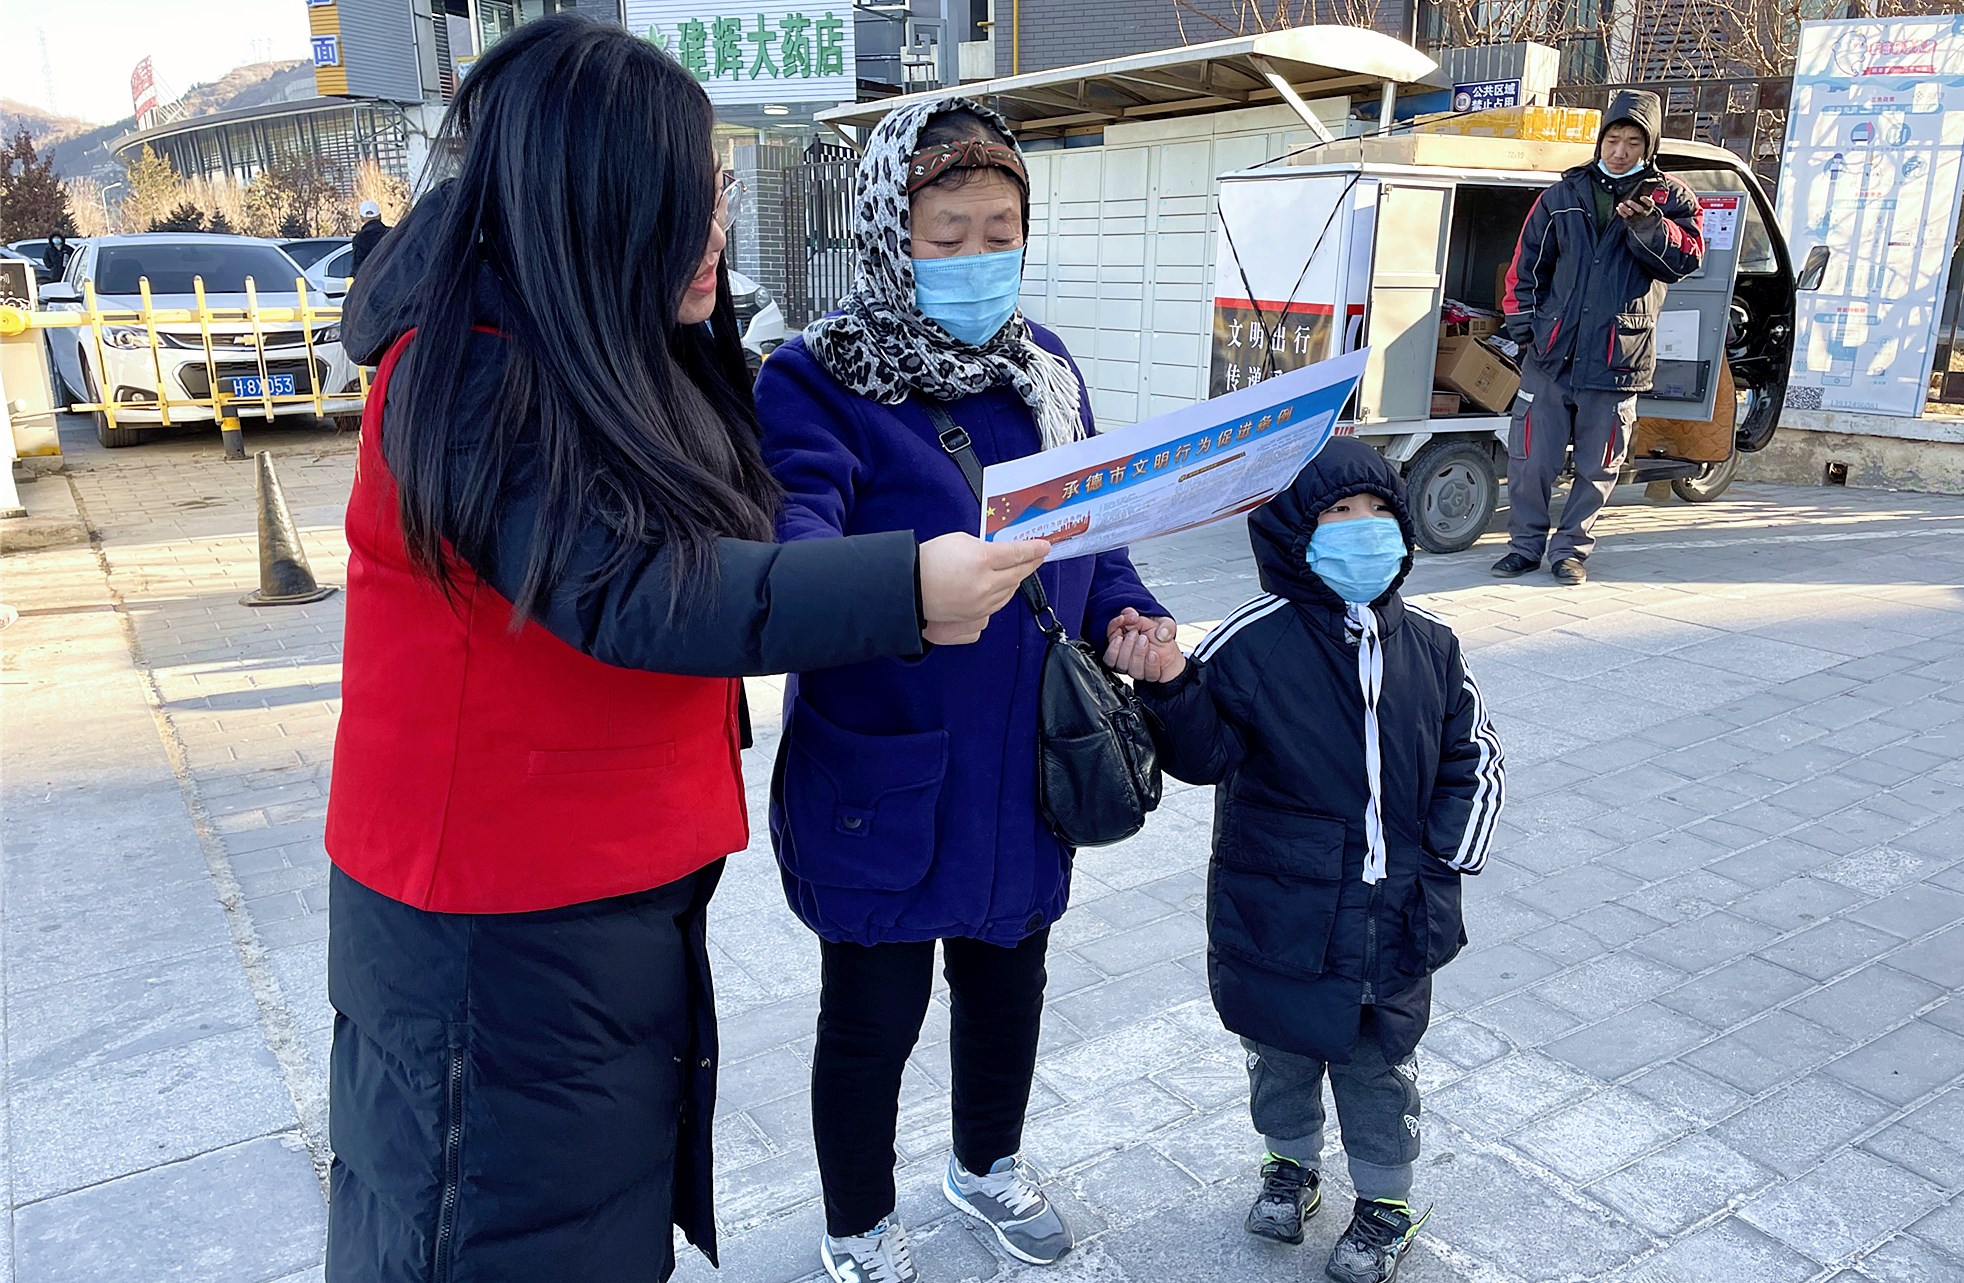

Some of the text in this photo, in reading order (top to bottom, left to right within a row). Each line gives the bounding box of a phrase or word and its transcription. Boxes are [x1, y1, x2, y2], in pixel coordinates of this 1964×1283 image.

[310, 35, 341, 67] 面
[677, 11, 844, 81] 建辉大药店
[1471, 97, 1515, 111] 禁止占用
[1472, 83, 1516, 98] 公共区域
[1227, 318, 1311, 355] 文明出行
[232, 377, 294, 398] H·8X053
[1061, 405, 1295, 500] 承德市文明行为促进条例
